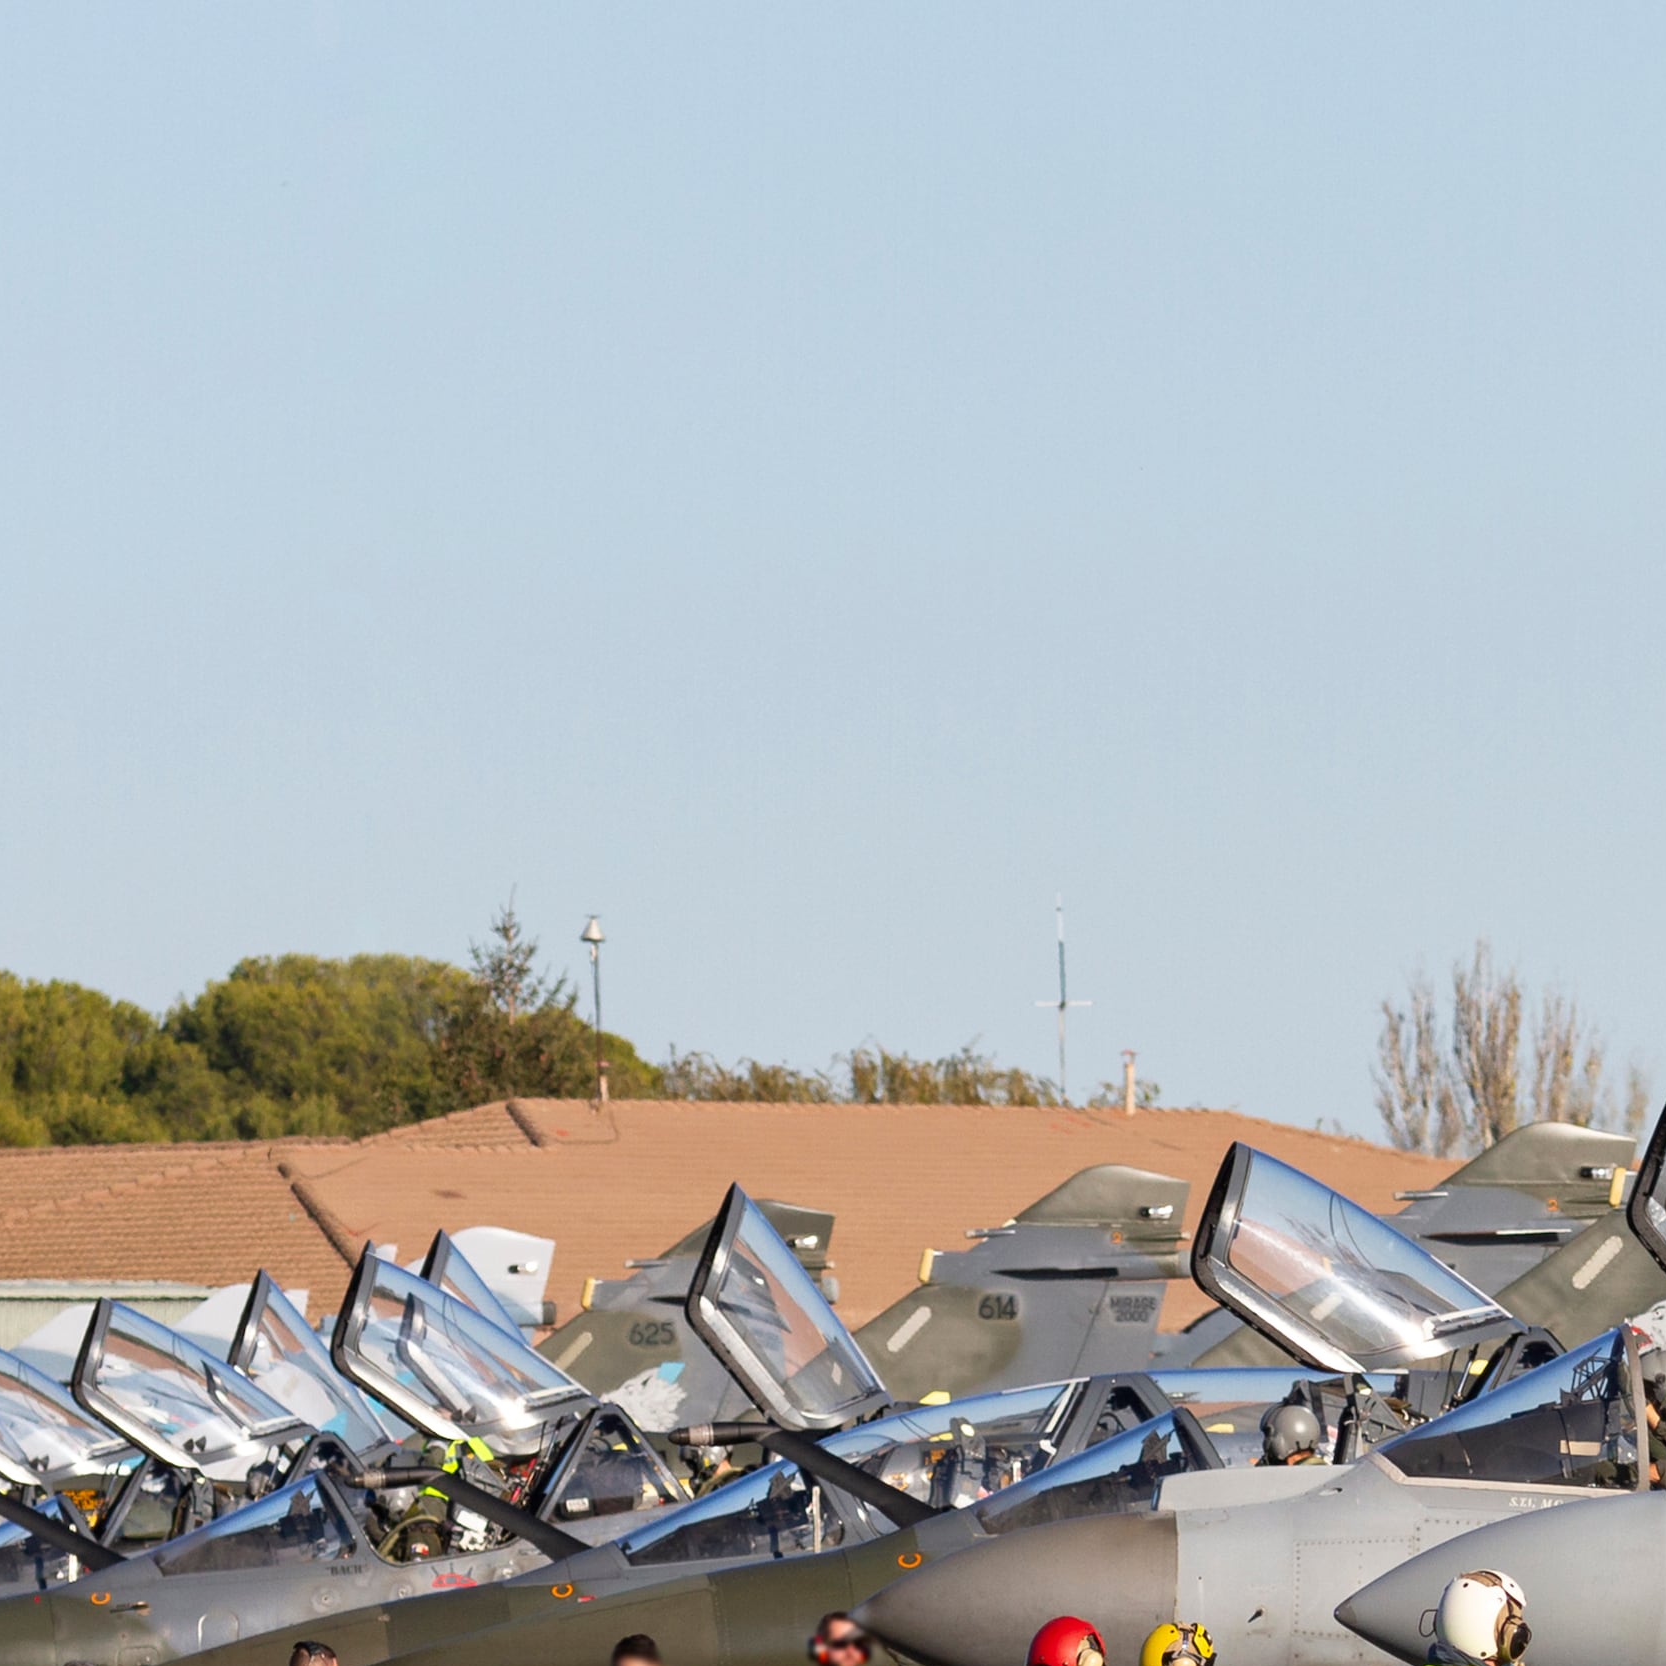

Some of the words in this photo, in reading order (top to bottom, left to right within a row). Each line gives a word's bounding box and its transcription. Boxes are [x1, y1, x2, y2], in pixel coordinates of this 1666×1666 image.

[978, 1296, 1017, 1320] 614
[1110, 1296, 1156, 1310] MIRAGE
[1116, 1309, 1148, 1322] 2000
[629, 1322, 675, 1345] 625
